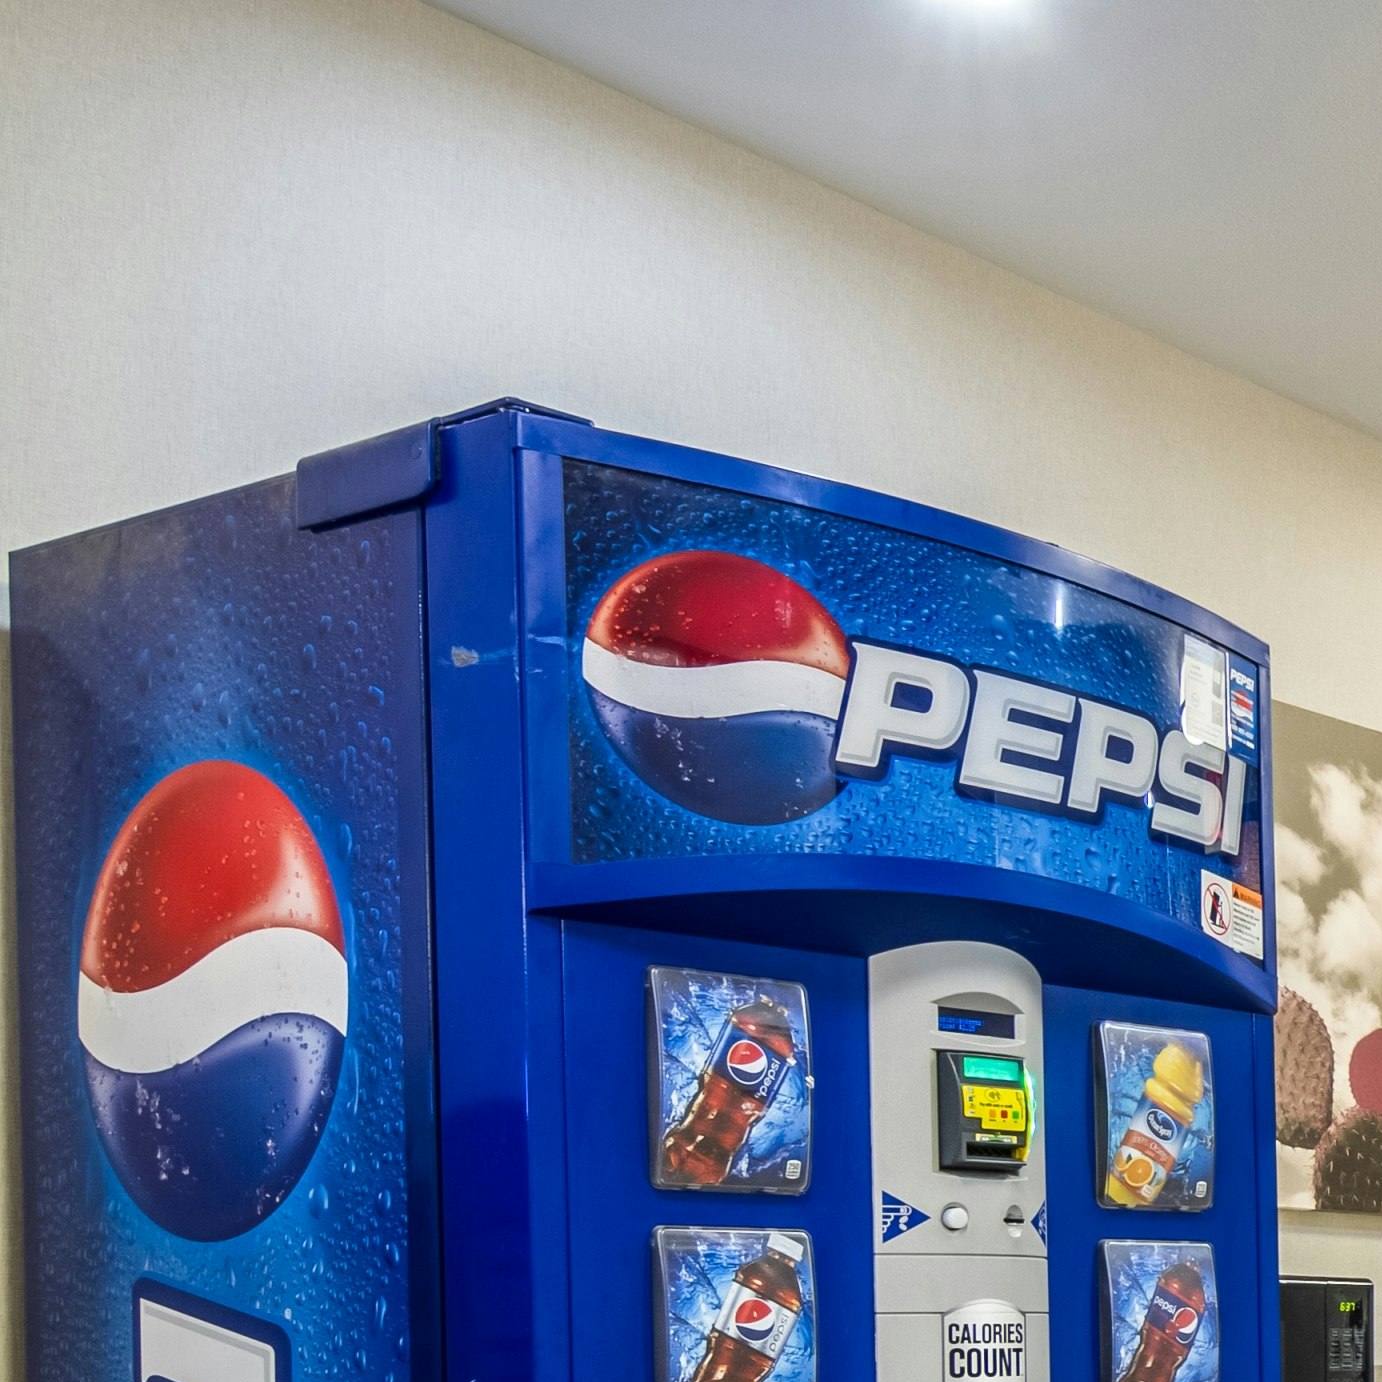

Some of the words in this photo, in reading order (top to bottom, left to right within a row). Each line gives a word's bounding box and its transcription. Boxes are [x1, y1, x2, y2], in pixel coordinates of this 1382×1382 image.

[1230, 668, 1255, 692] PEPSI
[835, 642, 1246, 856] PEPSI
[759, 1058, 781, 1097] pepsi
[1153, 1295, 1177, 1316] pepsi
[770, 1314, 790, 1352] pepsi
[948, 1322, 1023, 1344] CALORIES
[949, 1347, 1022, 1378] COUNT
